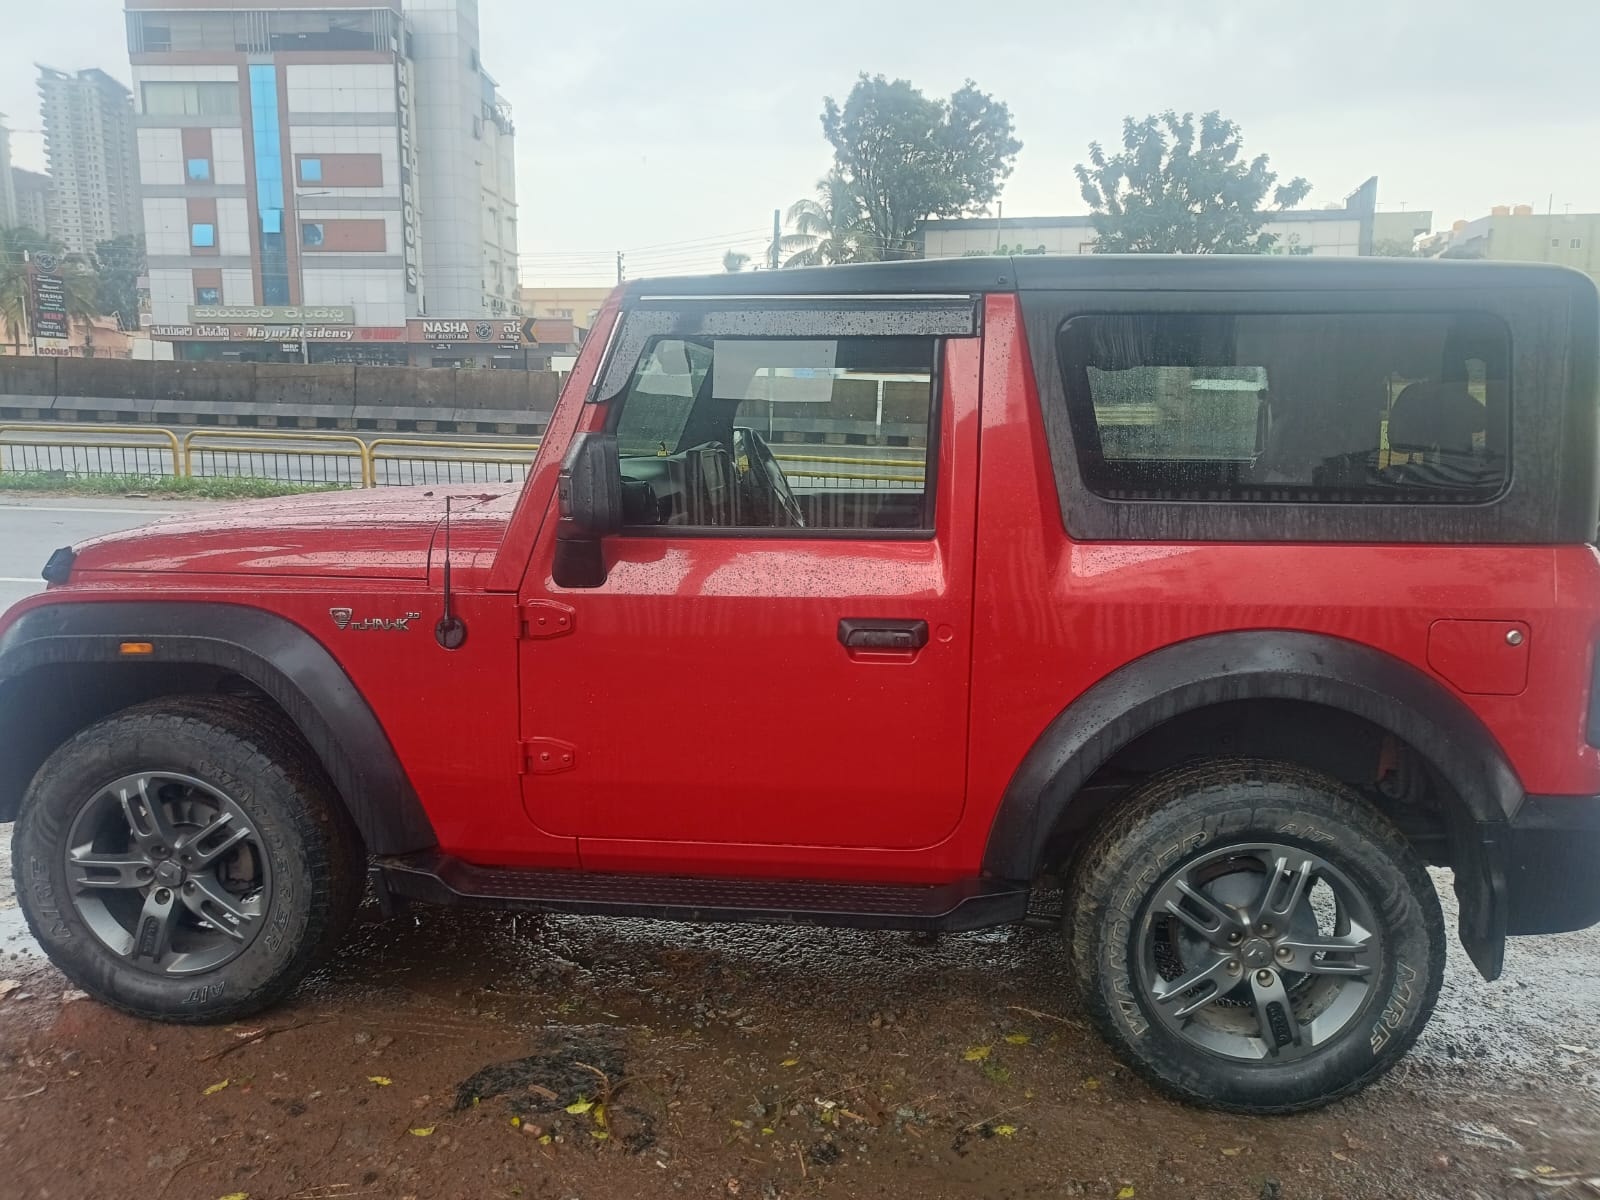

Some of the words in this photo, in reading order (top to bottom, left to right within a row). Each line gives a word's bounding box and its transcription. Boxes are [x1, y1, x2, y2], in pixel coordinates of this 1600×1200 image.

[398, 62, 410, 168] HOTEL
[403, 183, 416, 286] ROOMS
[38, 347, 70, 356] ROOMS
[246, 327, 290, 341] Mayuri
[423, 321, 470, 333] NASHA
[1109, 830, 1209, 1037] WANDERER
[1370, 960, 1417, 1056] MRF
